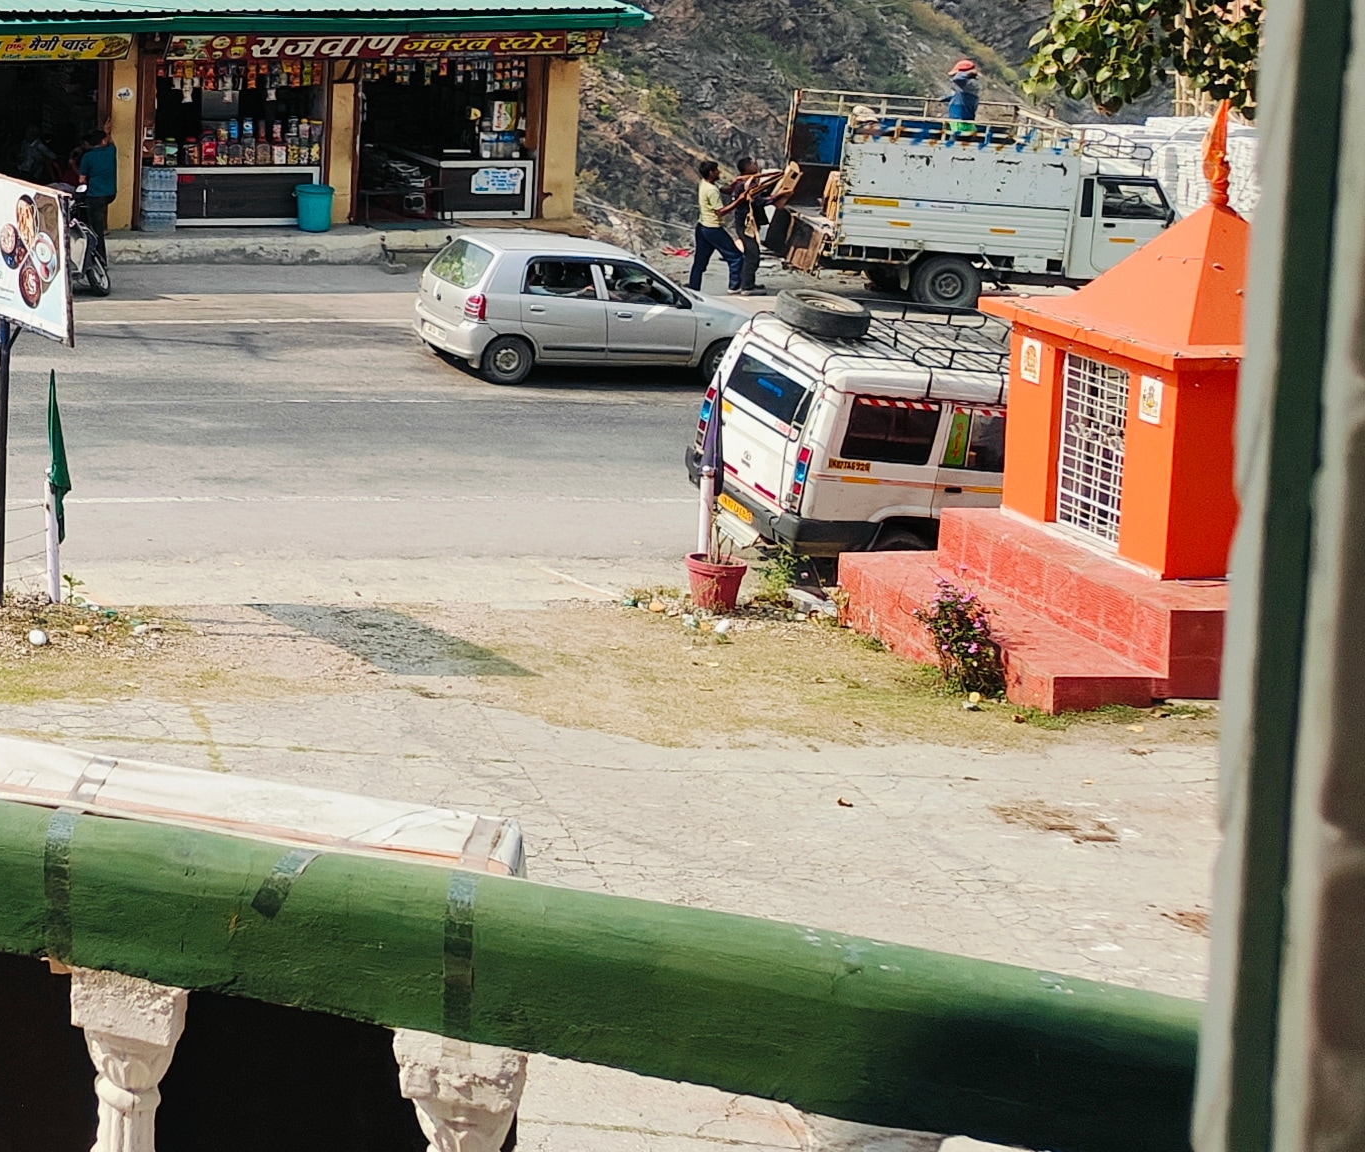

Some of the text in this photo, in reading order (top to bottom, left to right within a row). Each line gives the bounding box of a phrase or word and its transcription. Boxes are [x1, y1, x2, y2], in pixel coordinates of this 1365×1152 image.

[251, 31, 563, 57] सजवाण जनरल स्टोर
